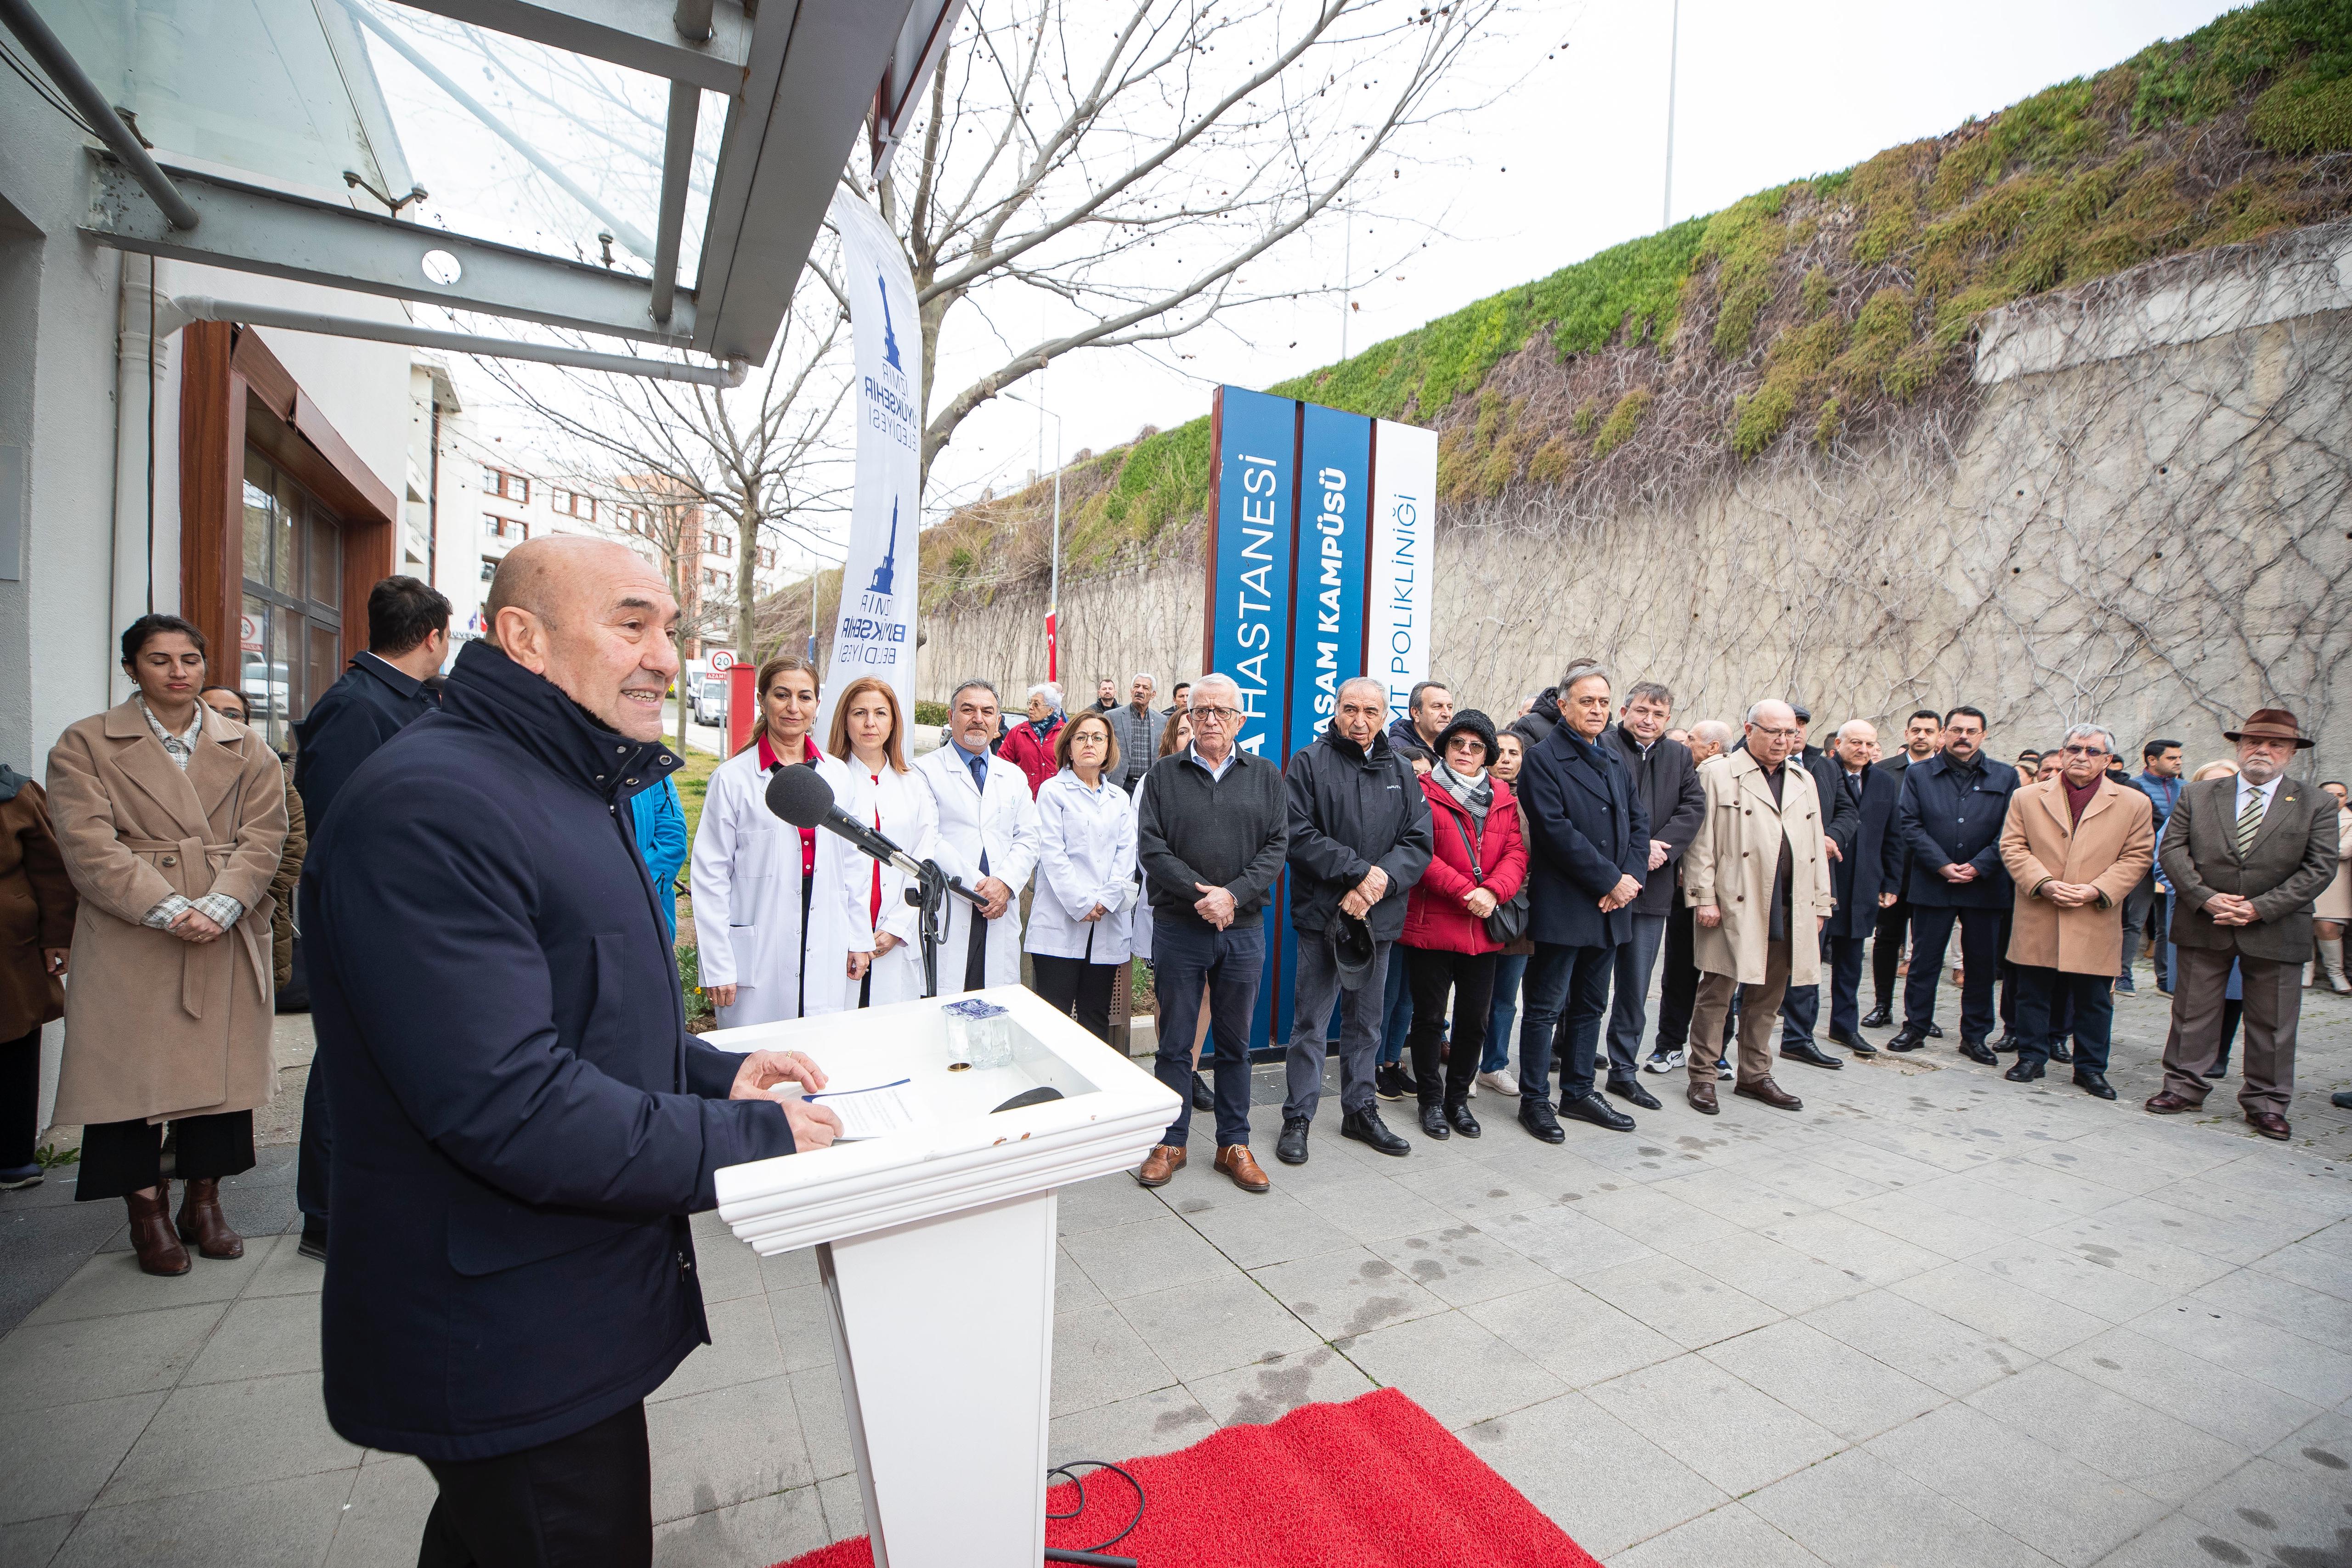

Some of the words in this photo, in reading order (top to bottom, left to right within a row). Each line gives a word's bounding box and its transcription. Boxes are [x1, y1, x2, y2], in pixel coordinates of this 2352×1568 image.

[1236, 454, 1277, 718] HASTANESİ
[1317, 467, 1346, 634] KAMPÜSÜ
[1390, 494, 1417, 674] POLİKLİNİĞİ
[717, 657, 729, 666] 20
[1389, 685, 1408, 727] MT
